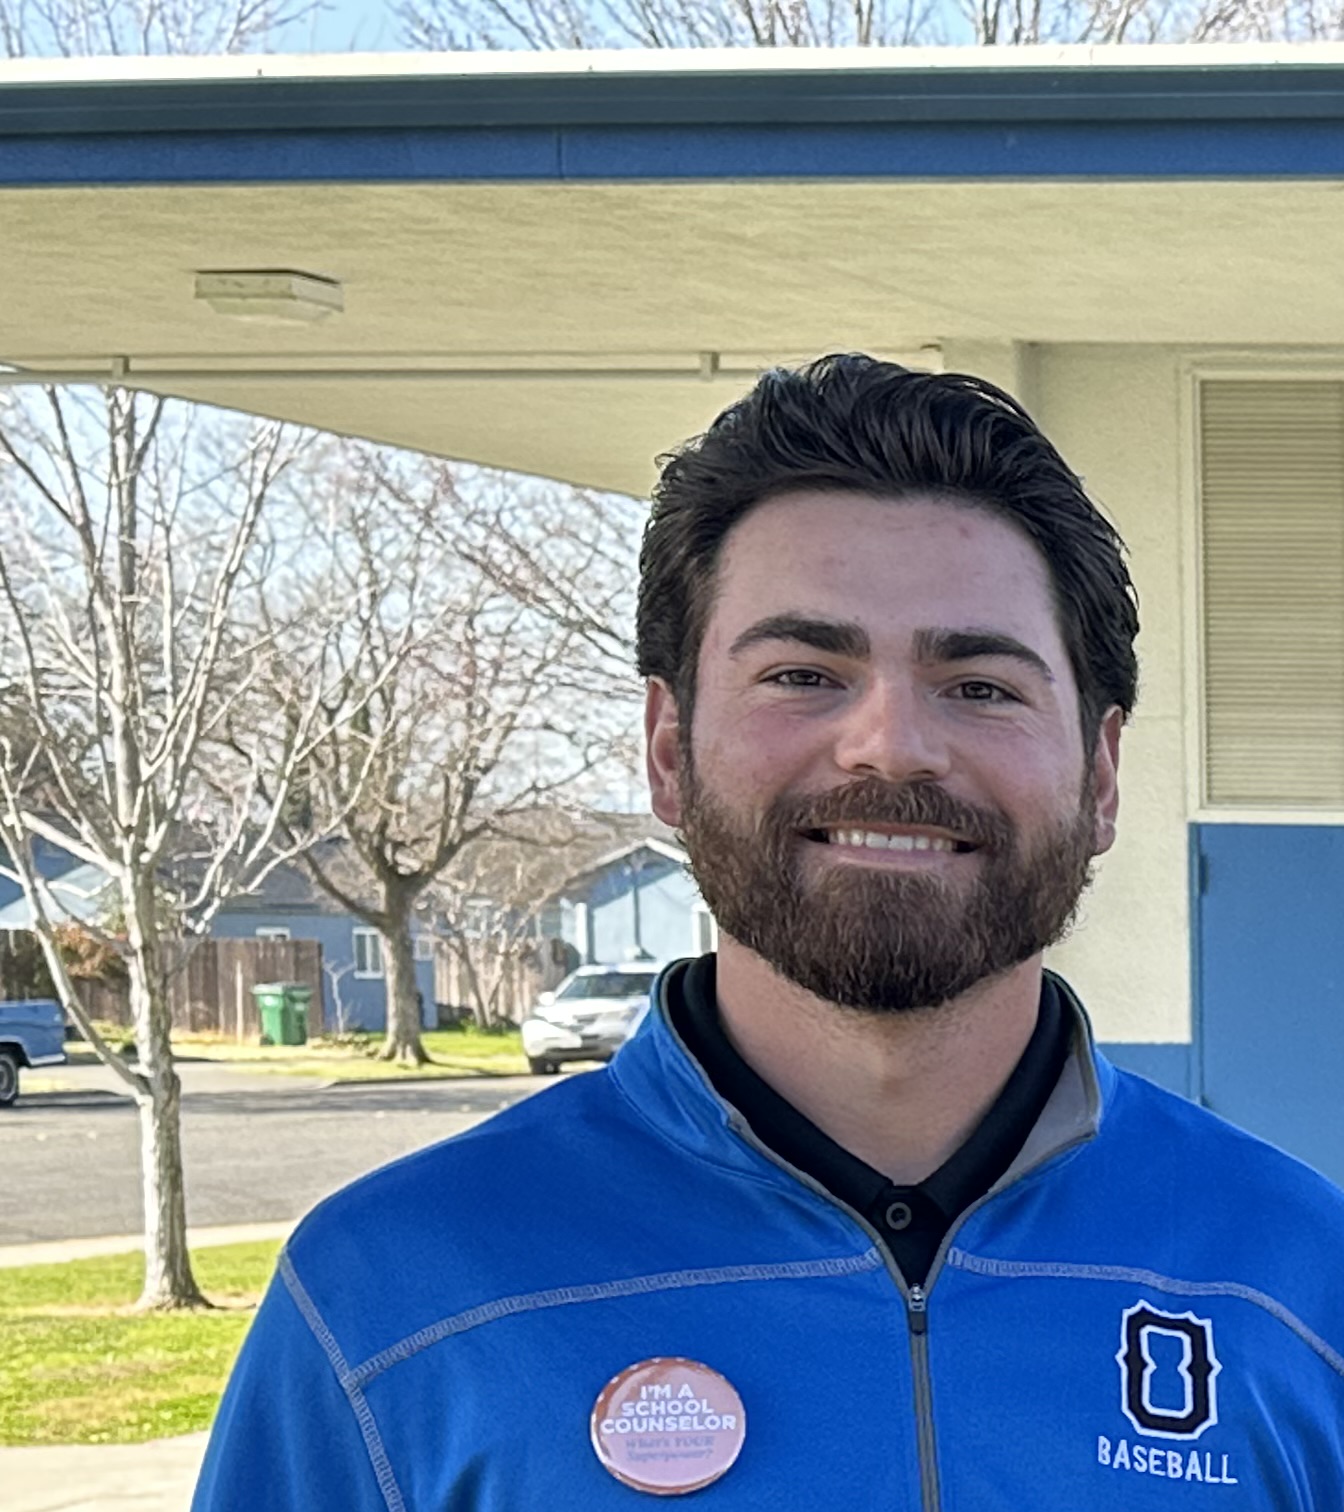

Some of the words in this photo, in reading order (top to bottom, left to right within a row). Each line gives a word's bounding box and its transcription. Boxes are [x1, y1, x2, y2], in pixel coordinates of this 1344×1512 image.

[640, 1385, 671, 1399] I'M
[677, 1383, 694, 1399] A
[621, 1399, 714, 1417] SCHOOL
[600, 1415, 736, 1434] COUNSELOR
[1098, 1435, 1238, 1484] BASEBALL
